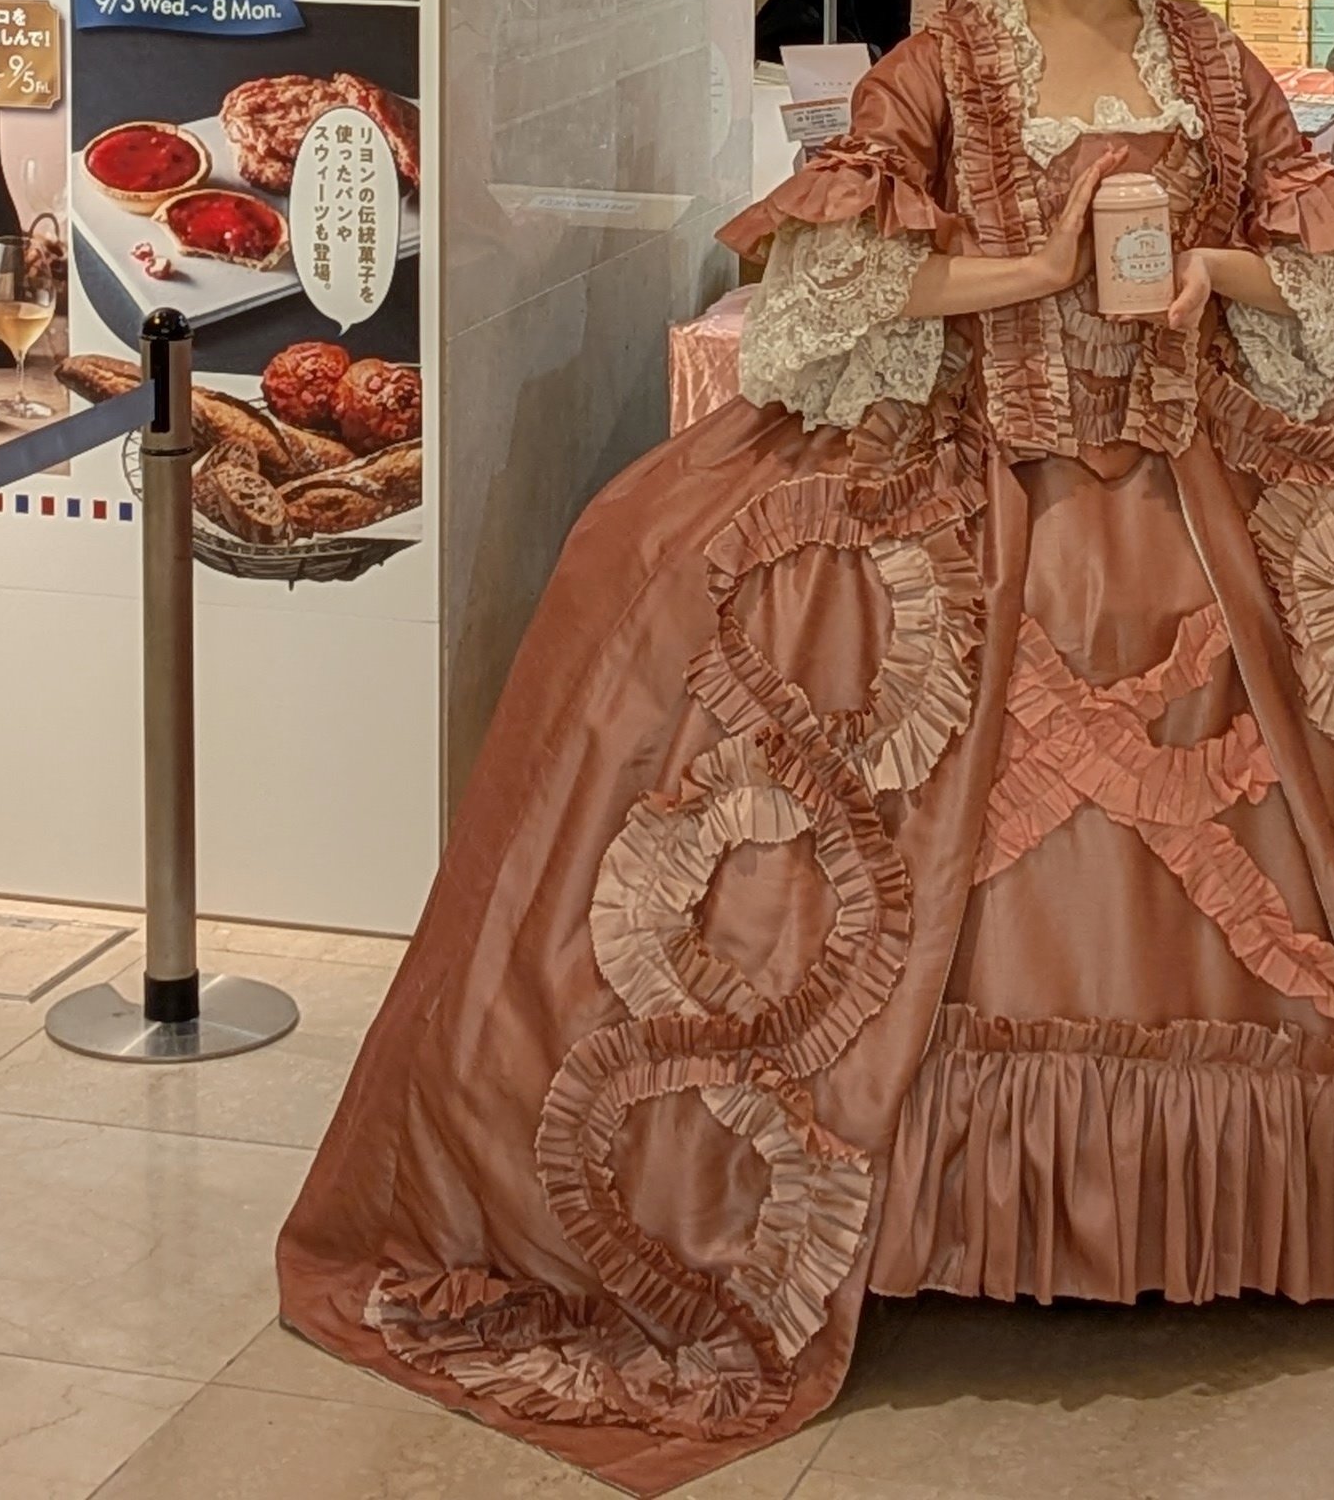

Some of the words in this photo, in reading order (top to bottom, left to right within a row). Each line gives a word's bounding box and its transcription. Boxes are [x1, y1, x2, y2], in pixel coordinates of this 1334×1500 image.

[231, 0, 282, 20] Mon.
[358, 126, 376, 304] リヨンの伝統菓子を
